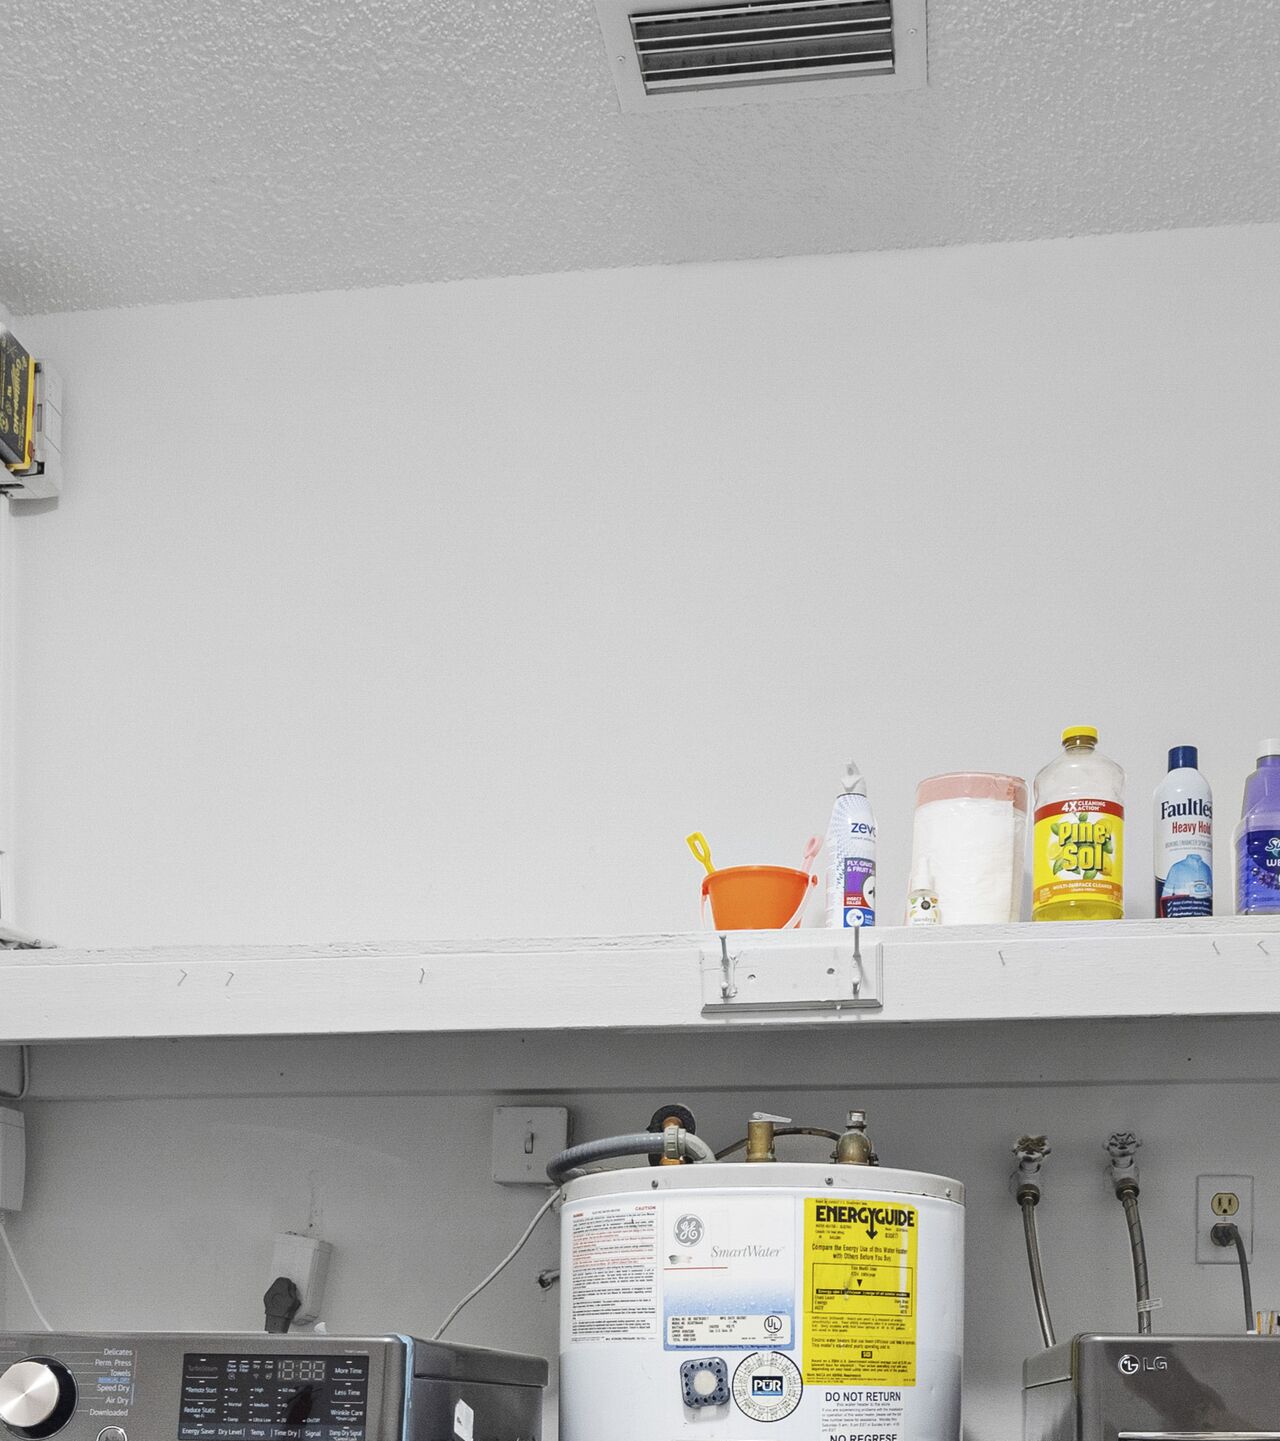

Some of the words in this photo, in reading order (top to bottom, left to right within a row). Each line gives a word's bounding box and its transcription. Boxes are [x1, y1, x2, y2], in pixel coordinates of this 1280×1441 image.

[1061, 801, 1078, 812] 4X
[1172, 821, 1197, 835] Heavy
[1062, 843, 1104, 872] Sol
[816, 1205, 915, 1227] ENERGYGUIDE
[812, 1243, 833, 1251] Compare
[104, 1348, 133, 1356] Delicates
[114, 1359, 132, 1367] Press
[97, 1384, 117, 1393] Speed
[118, 1384, 130, 1394] Dry
[105, 1396, 115, 1404] Air
[117, 1396, 129, 1406] Dry
[825, 1391, 840, 1402] DO
[843, 1391, 863, 1402] NOT
[866, 1391, 901, 1402] RETURN
[90, 1408, 129, 1417] Downloaded
[184, 1406, 201, 1414] Reduce
[202, 1406, 216, 1414] Static
[182, 1428, 200, 1436] Energy
[218, 1428, 228, 1436] Dry
[305, 1430, 322, 1438] Signal
